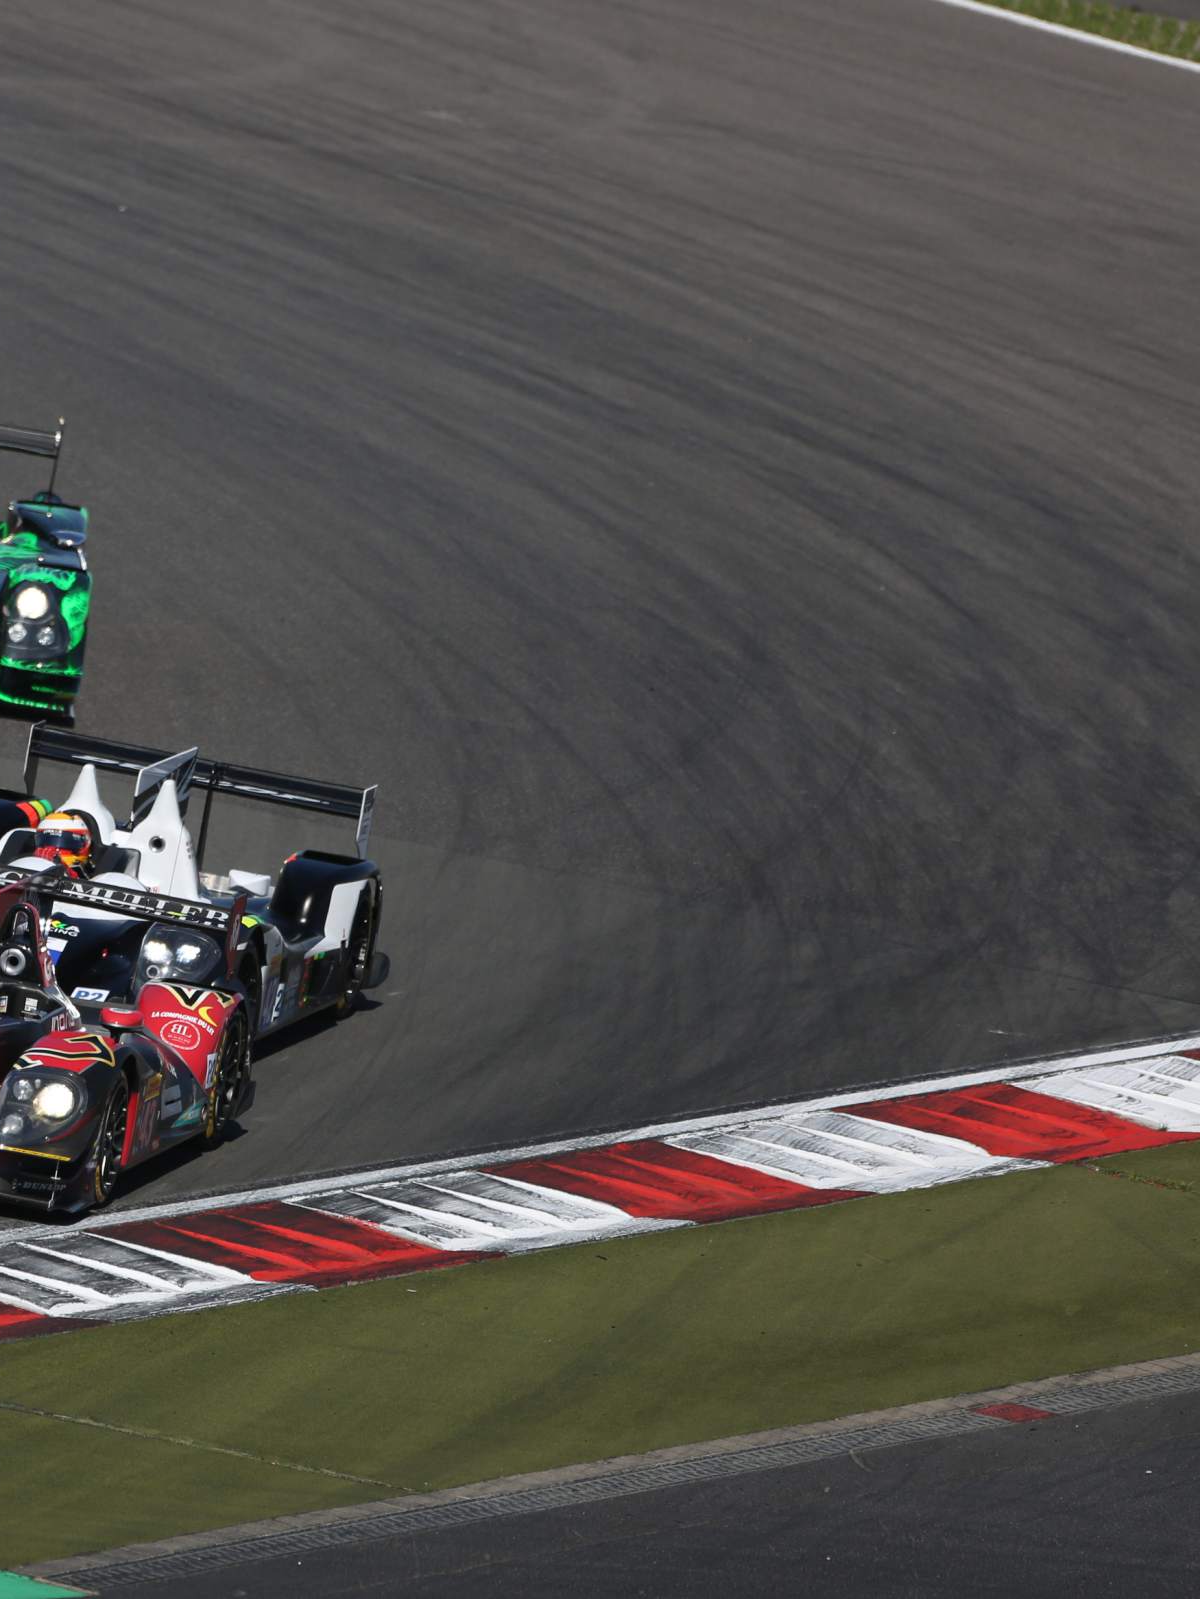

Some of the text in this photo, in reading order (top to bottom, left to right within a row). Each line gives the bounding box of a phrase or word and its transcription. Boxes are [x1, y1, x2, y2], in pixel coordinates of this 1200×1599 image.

[151, 1010, 160, 1018] LA
[160, 1011, 198, 1024] COMPAGNIE
[197, 1018, 207, 1028] DU
